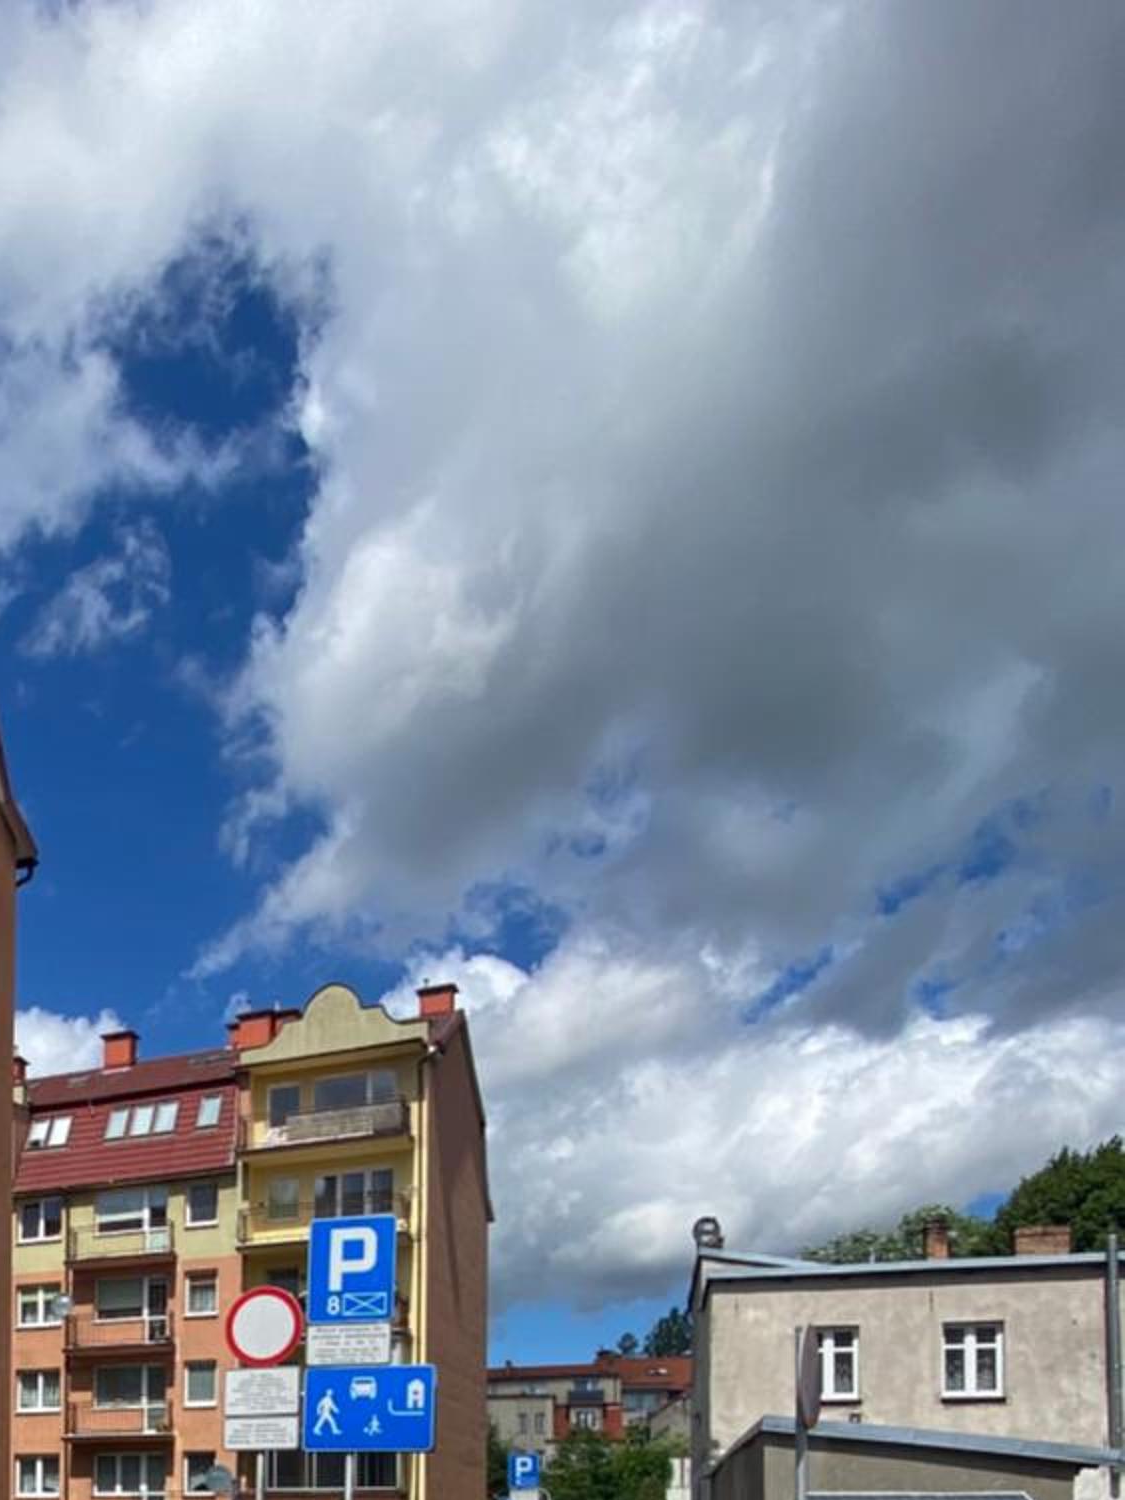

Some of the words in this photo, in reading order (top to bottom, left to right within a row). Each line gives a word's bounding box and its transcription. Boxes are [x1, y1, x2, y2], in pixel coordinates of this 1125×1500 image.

[329, 1228, 378, 1292] P
[327, 1296, 340, 1315] 8
[515, 1456, 533, 1478] P
